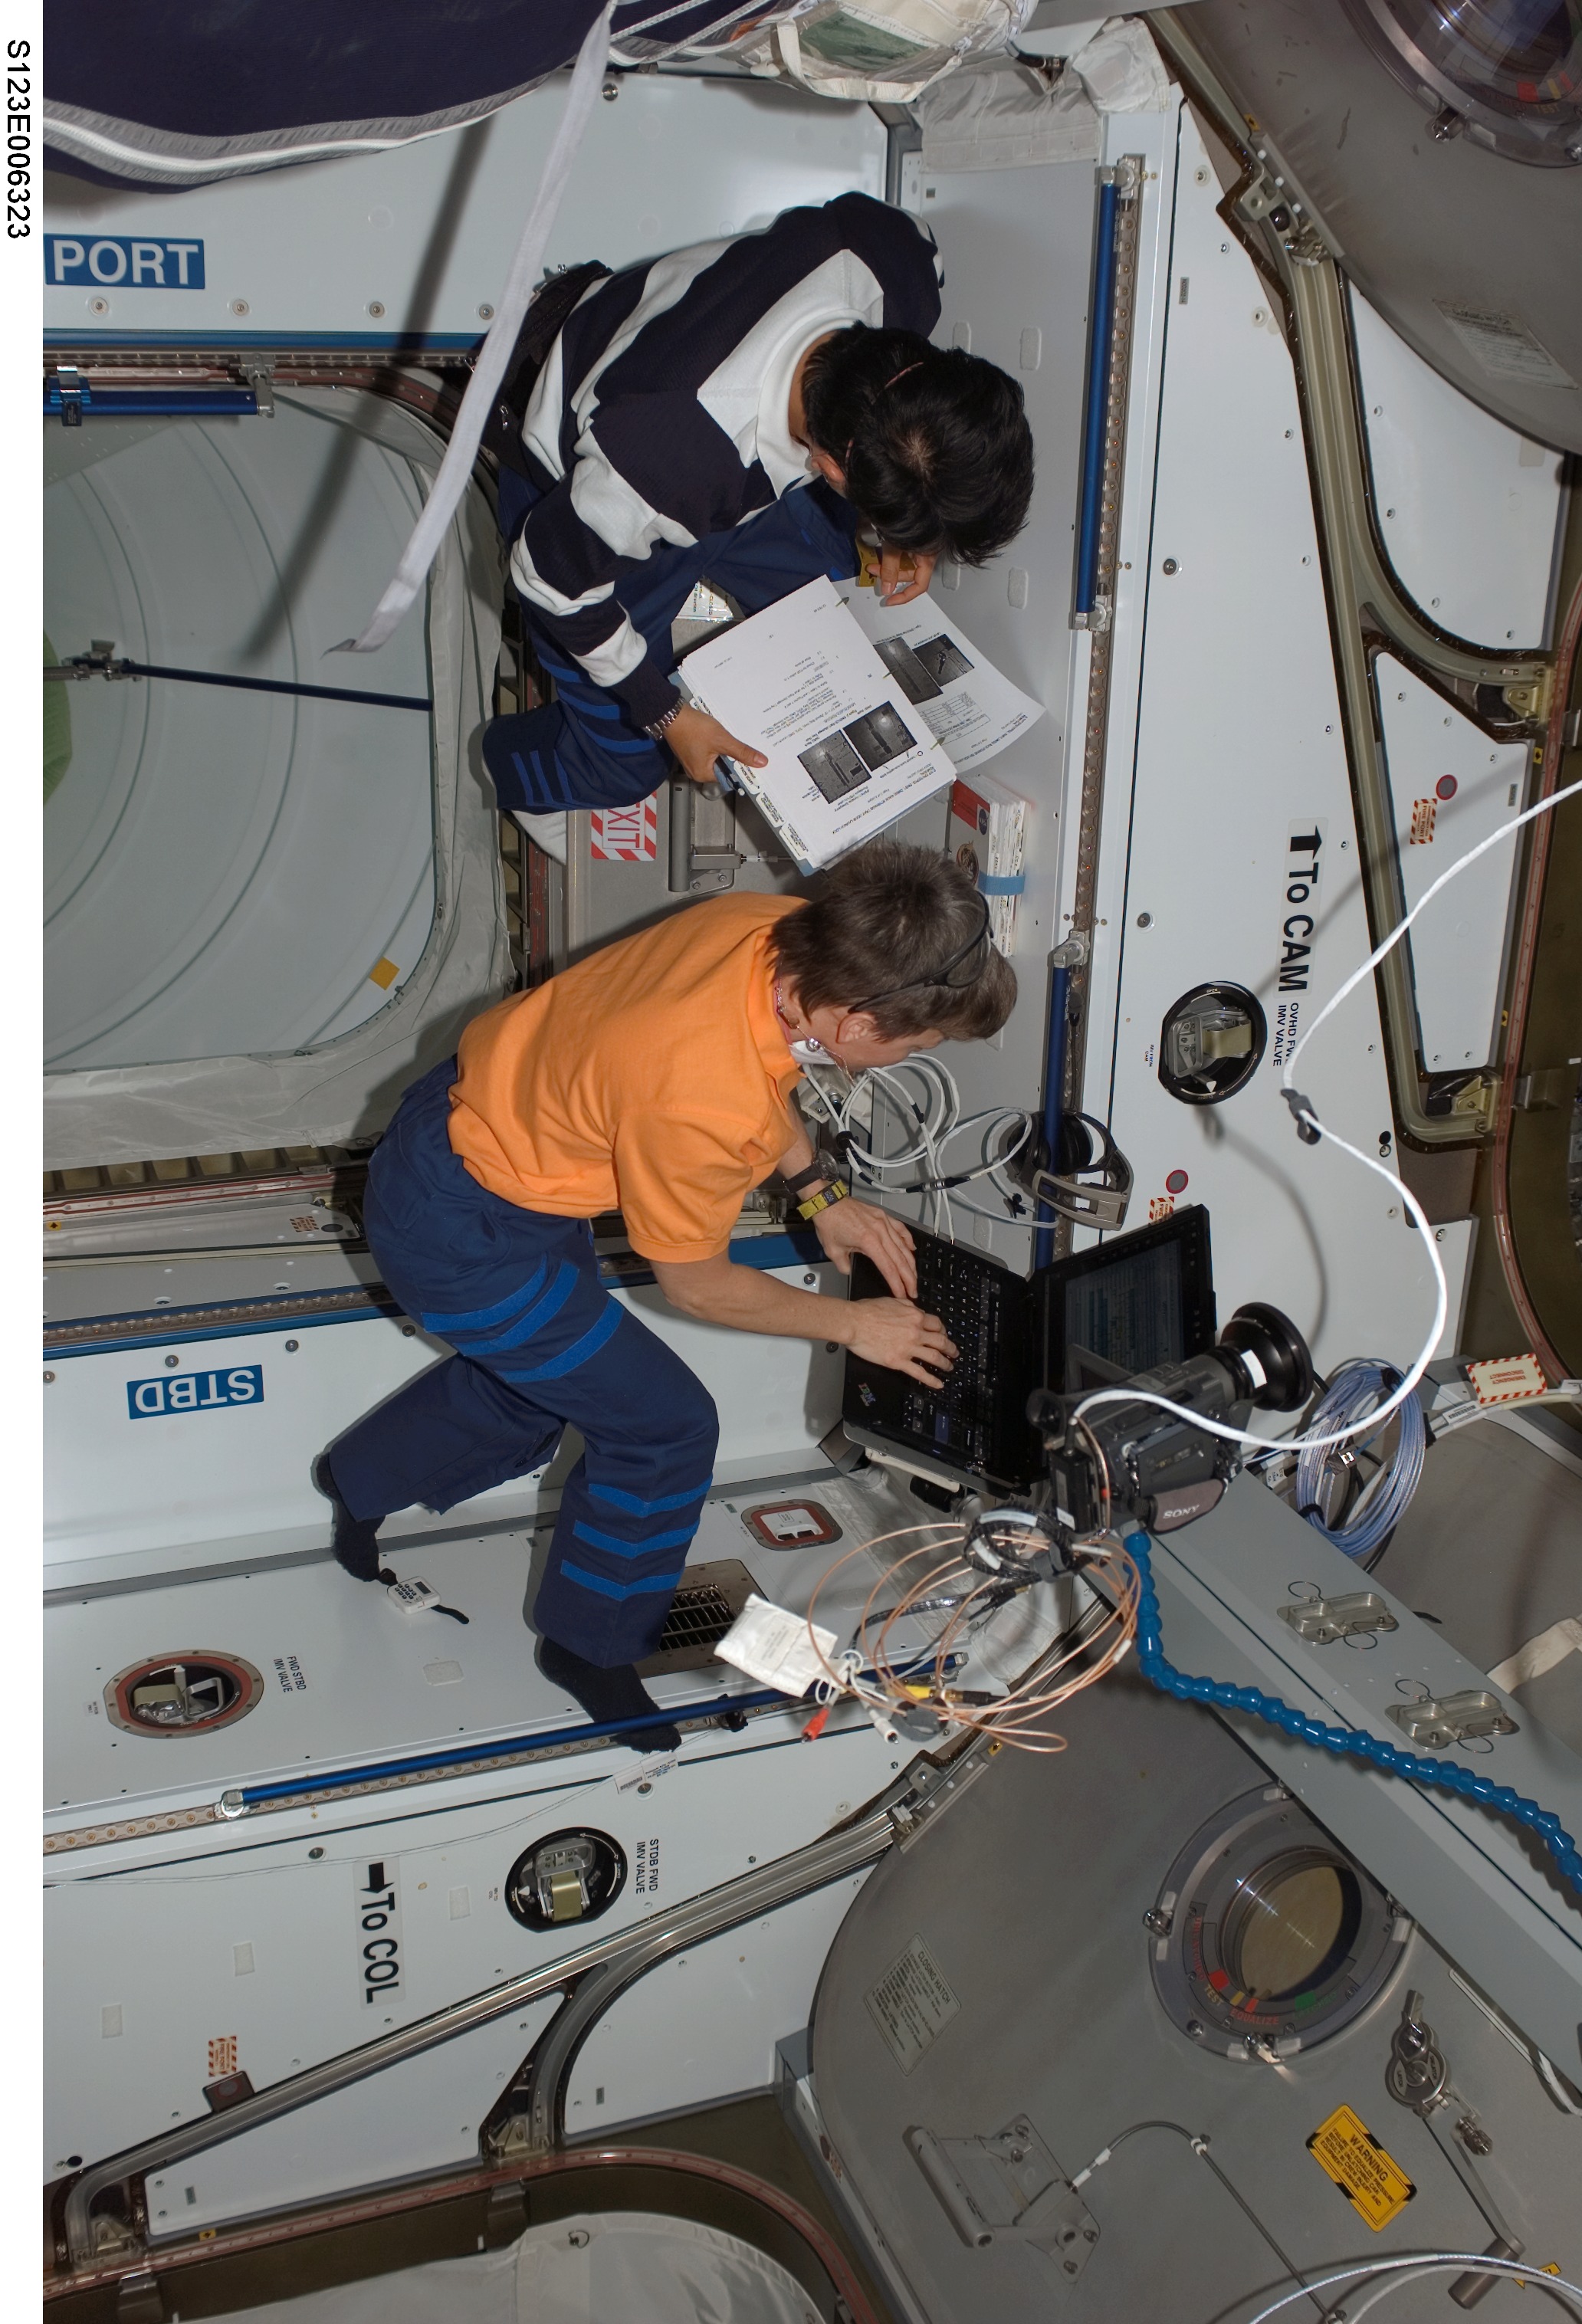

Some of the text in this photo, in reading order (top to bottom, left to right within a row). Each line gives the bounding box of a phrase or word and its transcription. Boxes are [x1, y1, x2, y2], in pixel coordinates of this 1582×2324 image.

[53, 241, 200, 284] PORT
[1278, 862, 1318, 991] To CAM
[1272, 1005, 1286, 1066] IMV VALVE
[1285, 1003, 1298, 1063] OVHD FW
[135, 1369, 257, 1414] STBD
[858, 1382, 876, 1403] IBM
[1163, 1504, 1199, 1518] SONY
[273, 1658, 292, 1692] IMV VALVE
[287, 1656, 307, 1690] FWD STBD
[636, 1841, 645, 1894] IMV VALVE
[649, 1838, 658, 1891] STDB FWD
[361, 1895, 399, 2004] To COL
[917, 1951, 950, 2004] CLOSING HATCH
[1203, 1983, 1223, 2006] TEST
[1229, 2007, 1278, 2024] EQUALIZE
[1320, 2140, 1344, 2168] EQUIPMENT
[1324, 2135, 1341, 2155] RESULT
[1344, 2161, 1357, 2176] CREW
[1356, 2176, 1372, 2194] INJURY
[1371, 2194, 1382, 2206] AND
[1328, 2132, 1345, 2152] BEFORE
[1344, 2151, 1370, 2184] UNLATCHING
[1332, 2128, 1349, 2148] FAILURE
[1354, 2155, 1374, 2178] EQUALIZE
[1373, 2178, 1395, 2204] PRESSURE
[1349, 2134, 1390, 2182] WARNING
